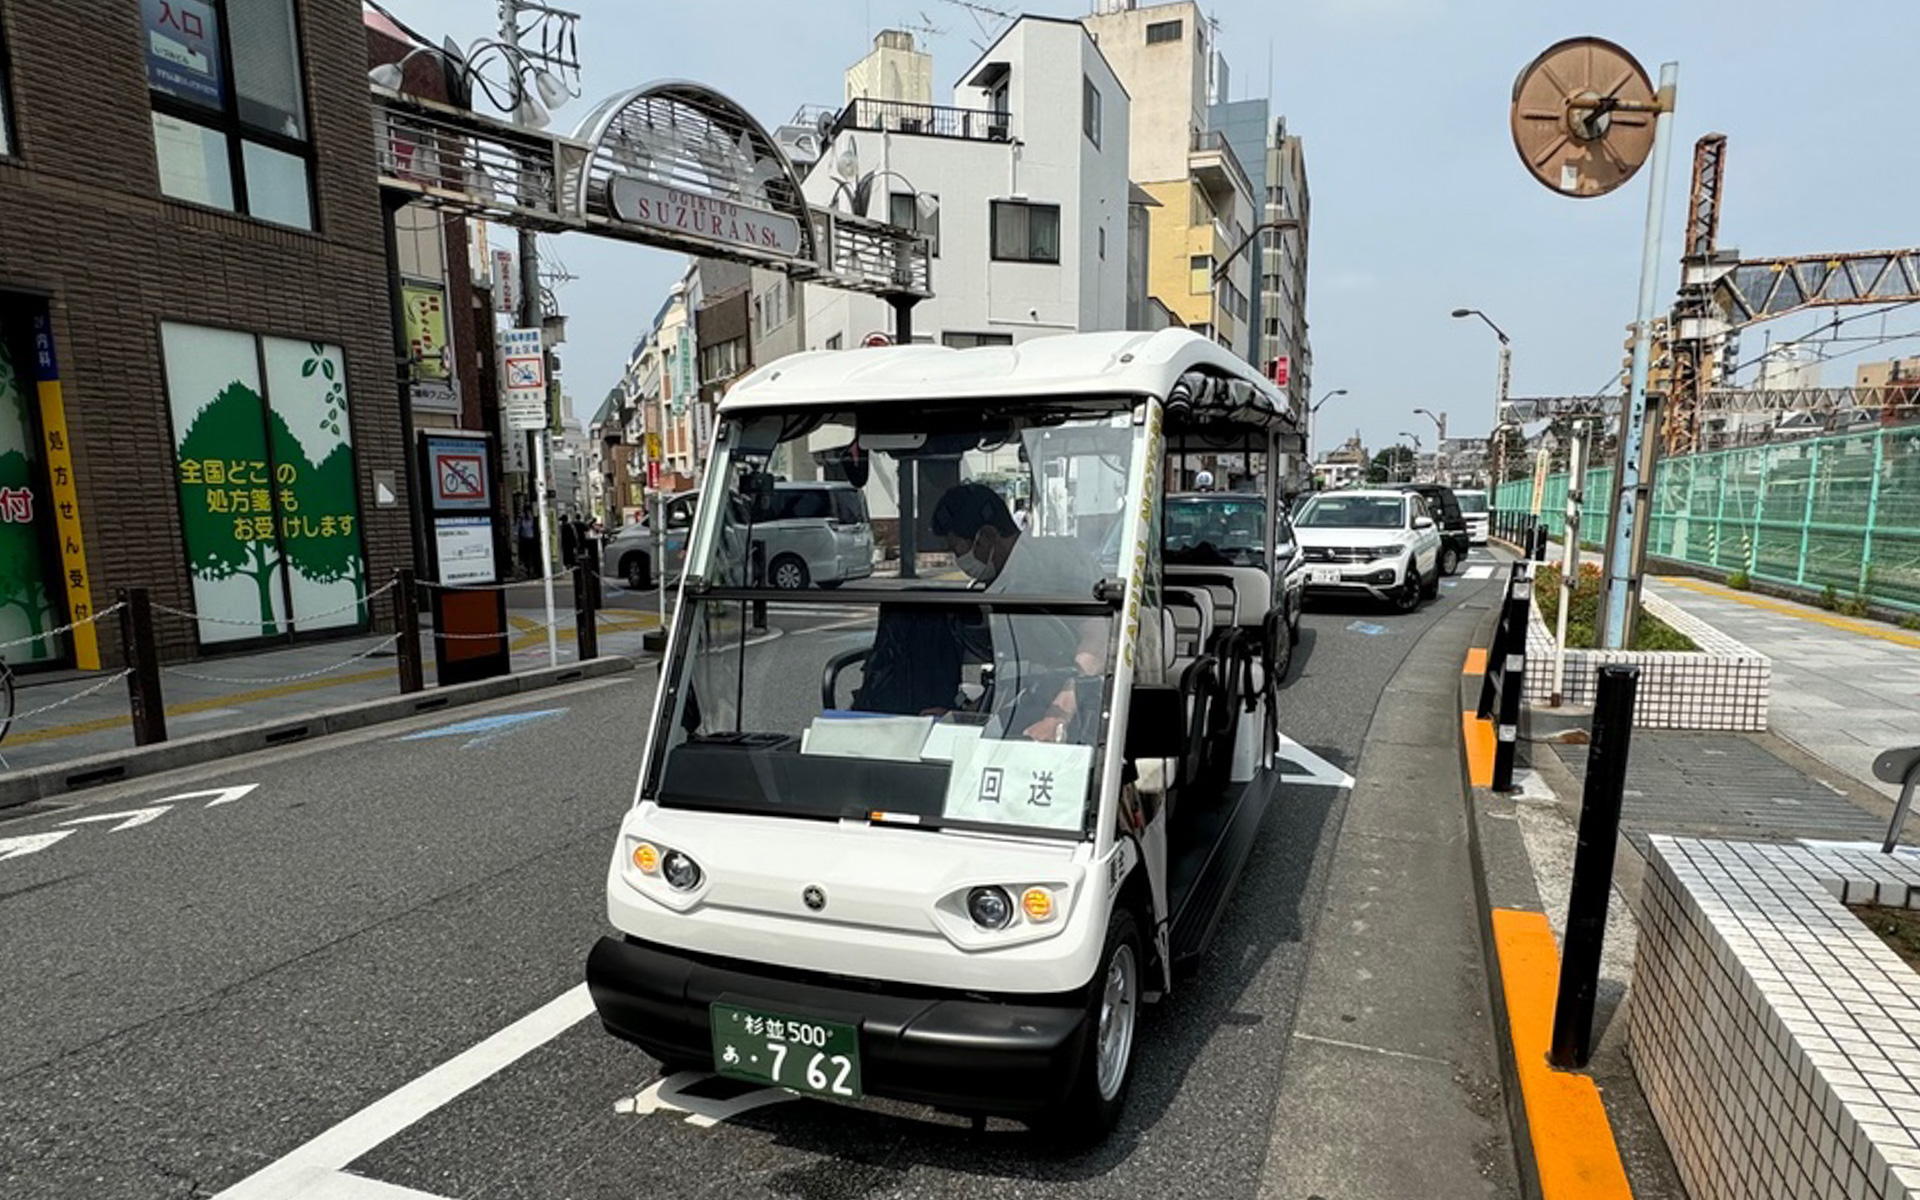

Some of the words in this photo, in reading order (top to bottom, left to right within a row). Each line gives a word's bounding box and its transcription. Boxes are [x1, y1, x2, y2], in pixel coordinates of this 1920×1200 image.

[159, 1, 203, 39] 入口
[669, 190, 737, 217] OGIKUBO
[639, 197, 757, 243] SUZURAN
[761, 227, 781, 248] St.
[179, 459, 297, 485] 全国どこの
[206, 488, 299, 513] 処方箋も
[48, 431, 89, 622] 処方せん受付
[233, 514, 355, 540] お受けします
